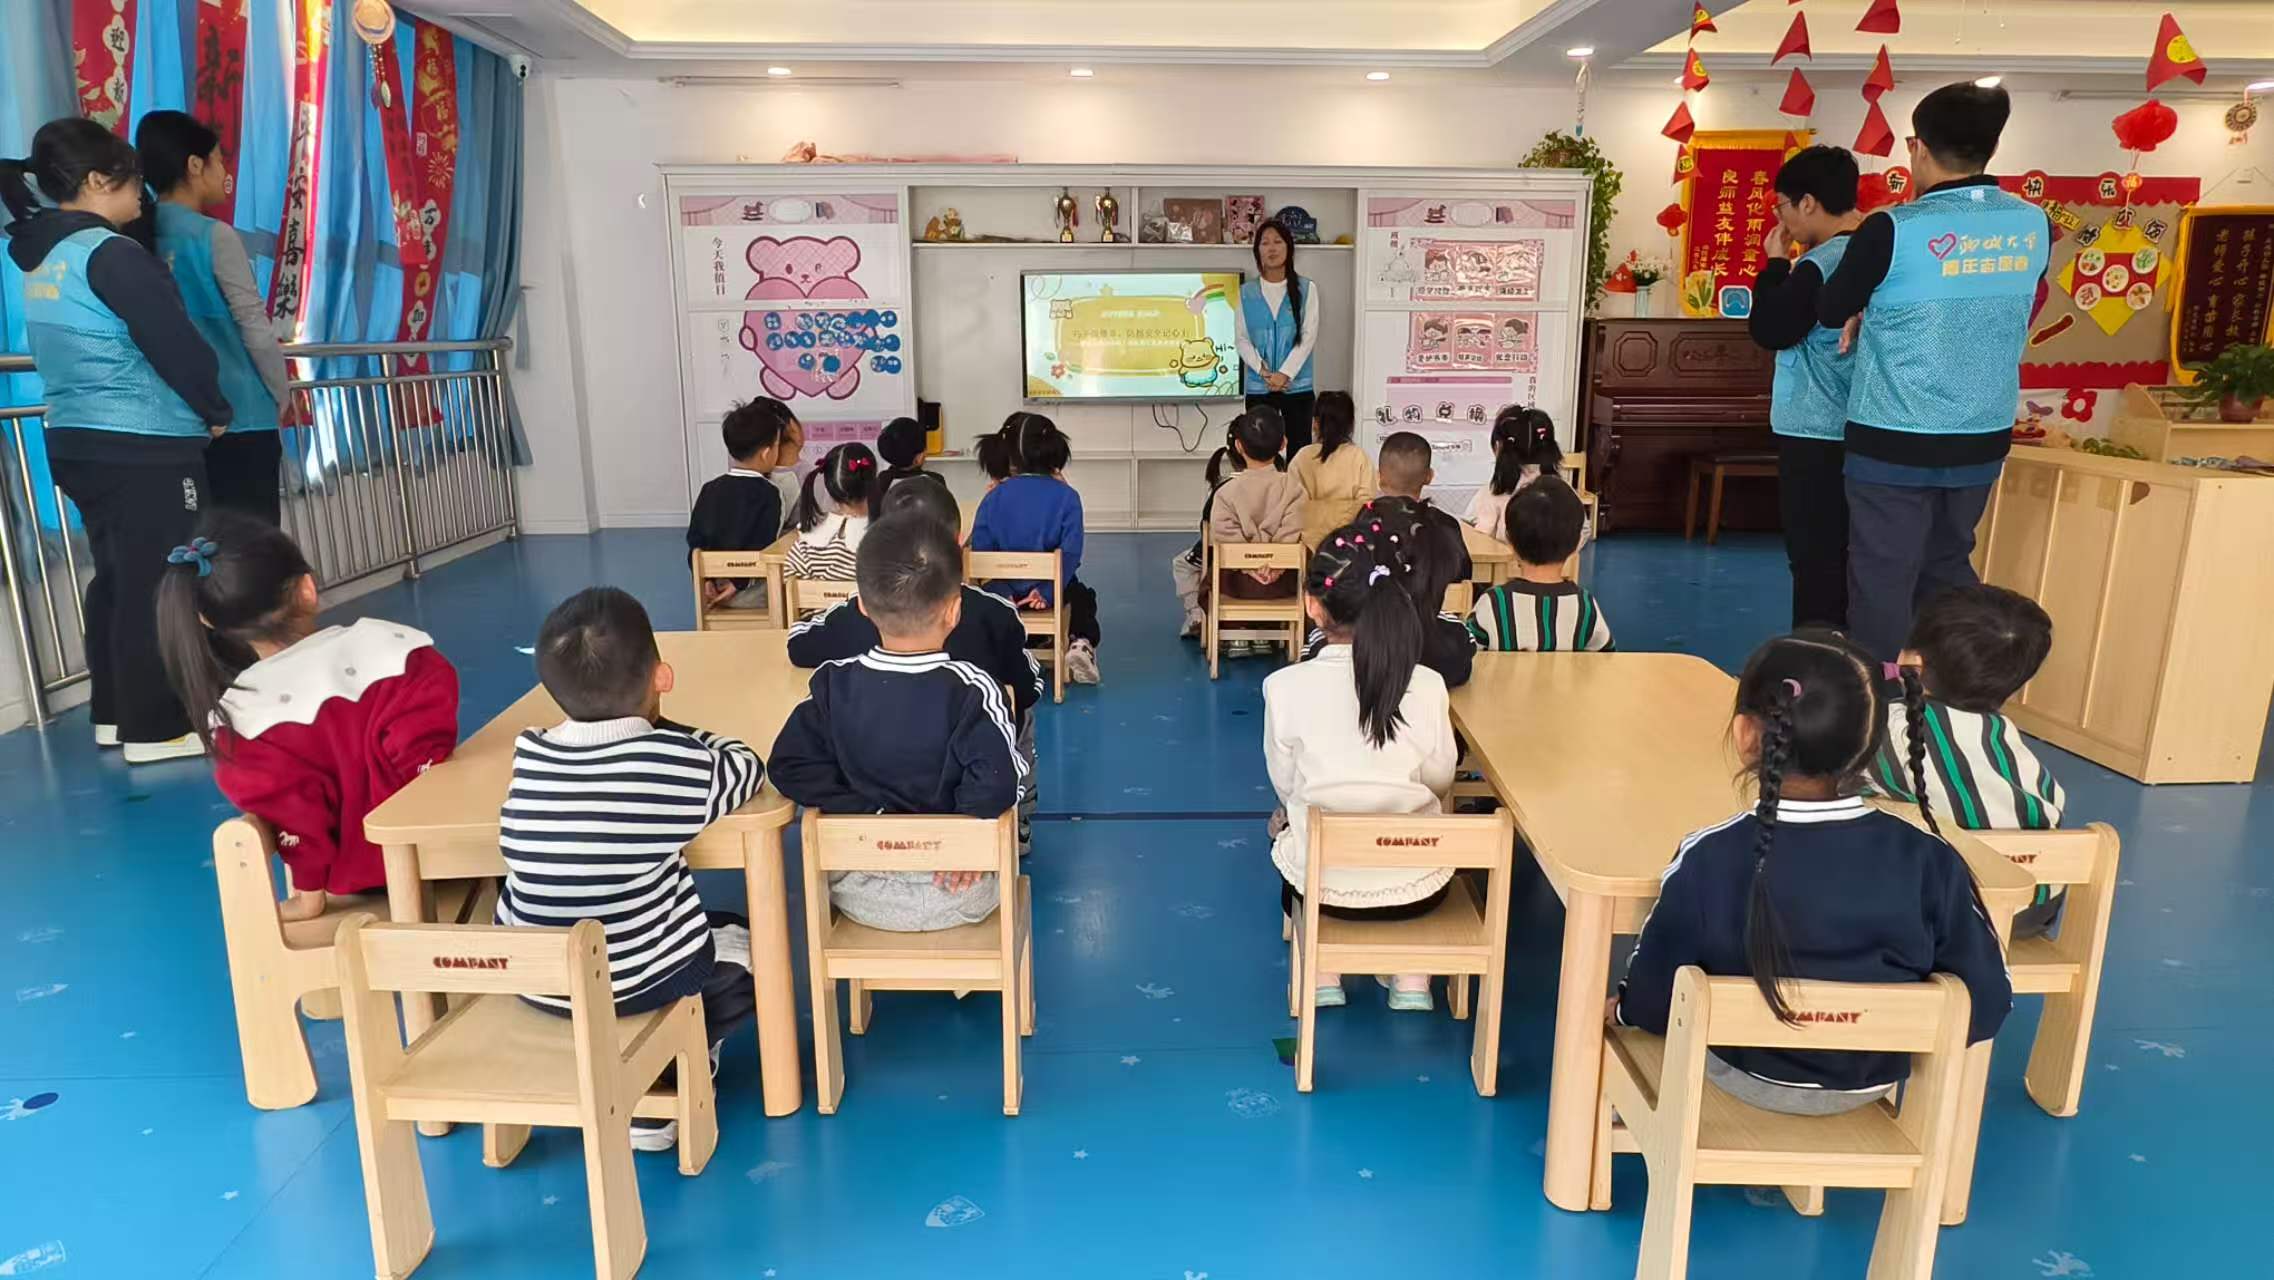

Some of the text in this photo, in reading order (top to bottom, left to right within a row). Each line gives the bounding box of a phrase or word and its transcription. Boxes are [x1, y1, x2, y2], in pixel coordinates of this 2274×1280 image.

[1376, 836, 1440, 847] COMPANY
[433, 956, 509, 970] COMPANY
[1786, 1011, 1861, 1023] OMPANY
